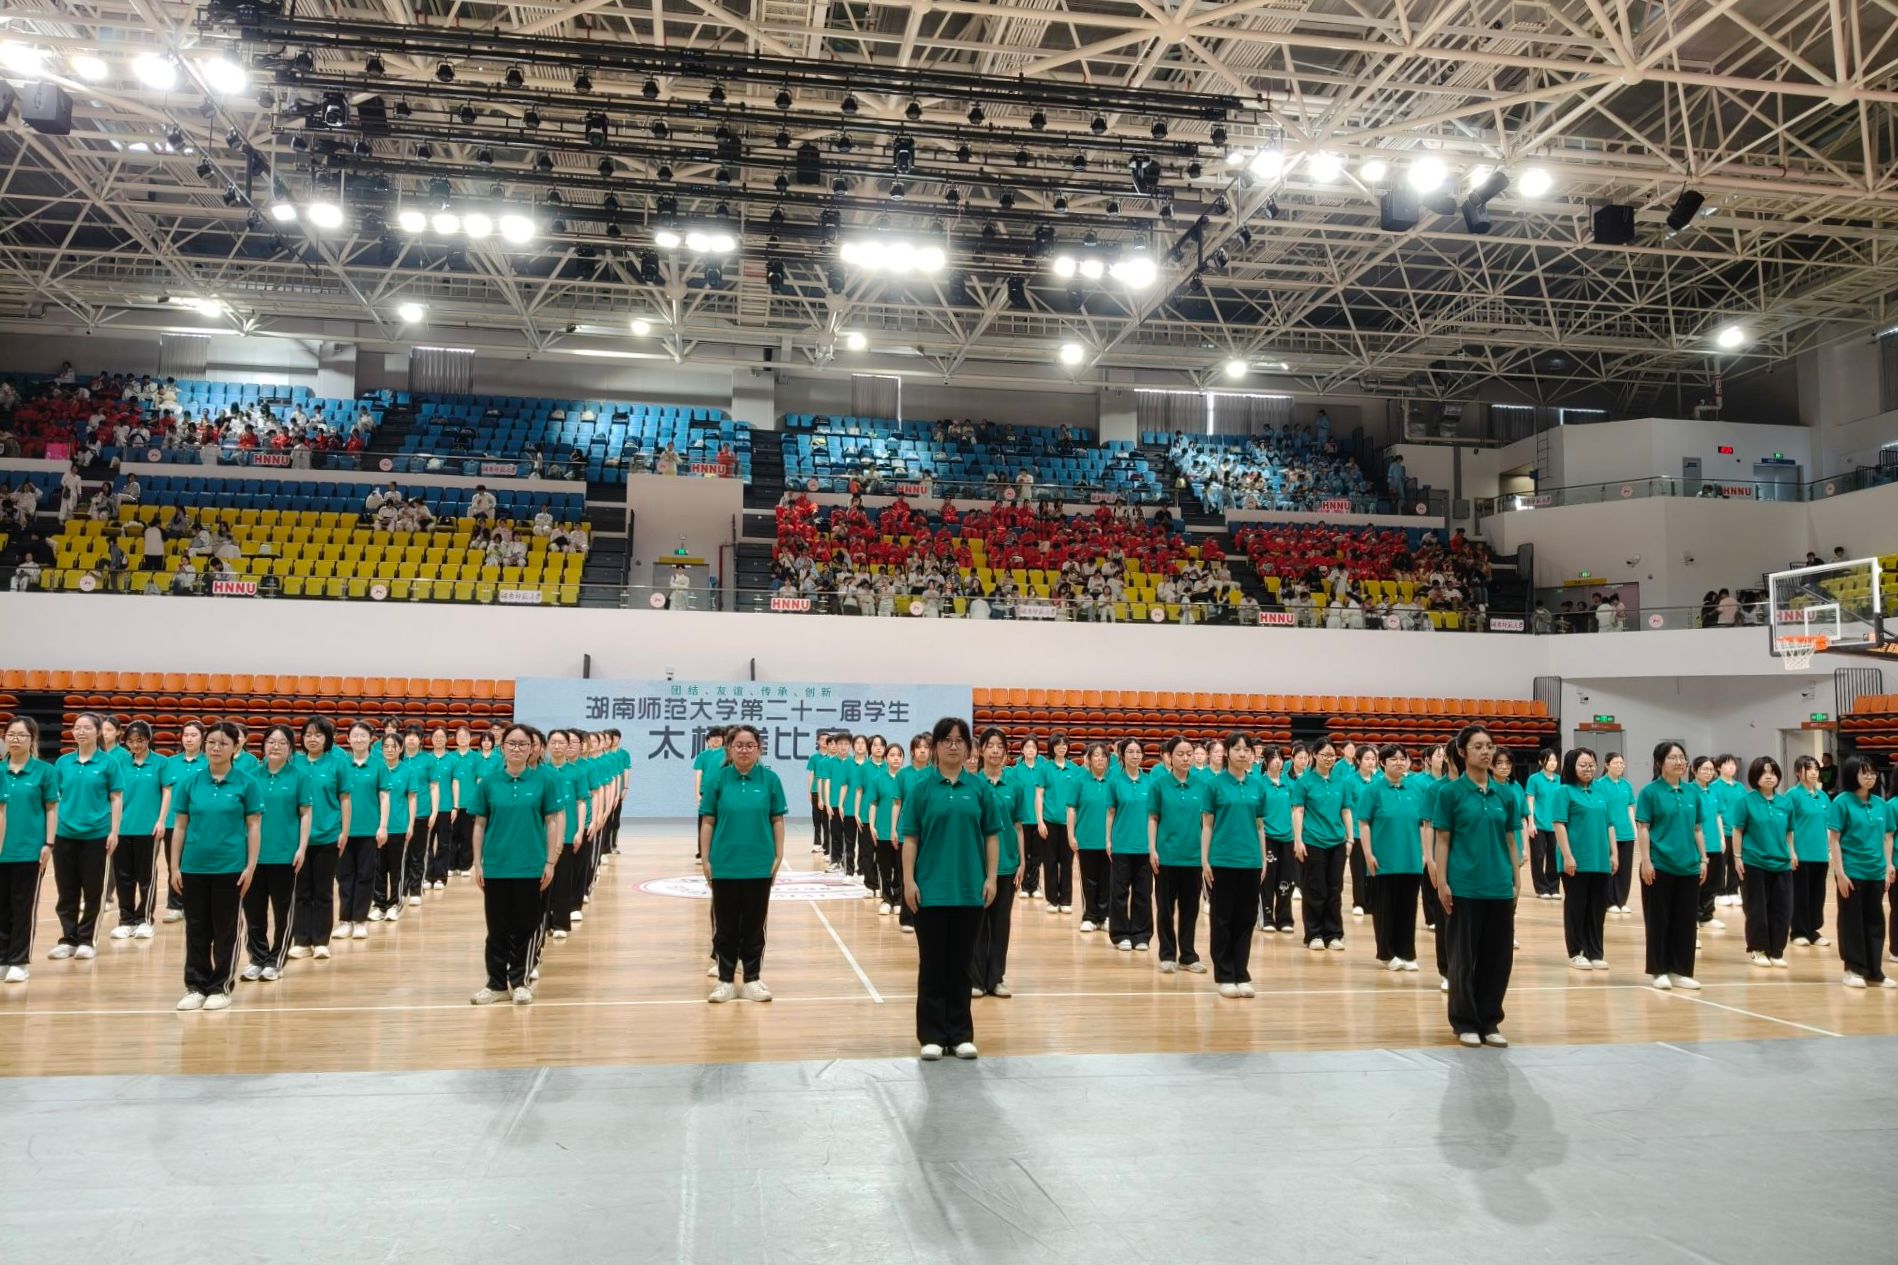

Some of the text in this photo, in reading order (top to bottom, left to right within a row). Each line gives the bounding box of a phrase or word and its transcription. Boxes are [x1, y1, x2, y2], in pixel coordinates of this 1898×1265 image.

[254, 454, 289, 465] HNNU
[692, 463, 726, 474] HNNU
[897, 483, 928, 494] HNNU
[1722, 486, 1752, 495] HNNU
[1322, 501, 1351, 511] HNNU
[214, 582, 256, 594] HNNU
[772, 599, 810, 610] HNNU
[1260, 614, 1294, 624] HNNU
[586, 696, 909, 723] 湖南师范大学第二十一届学生
